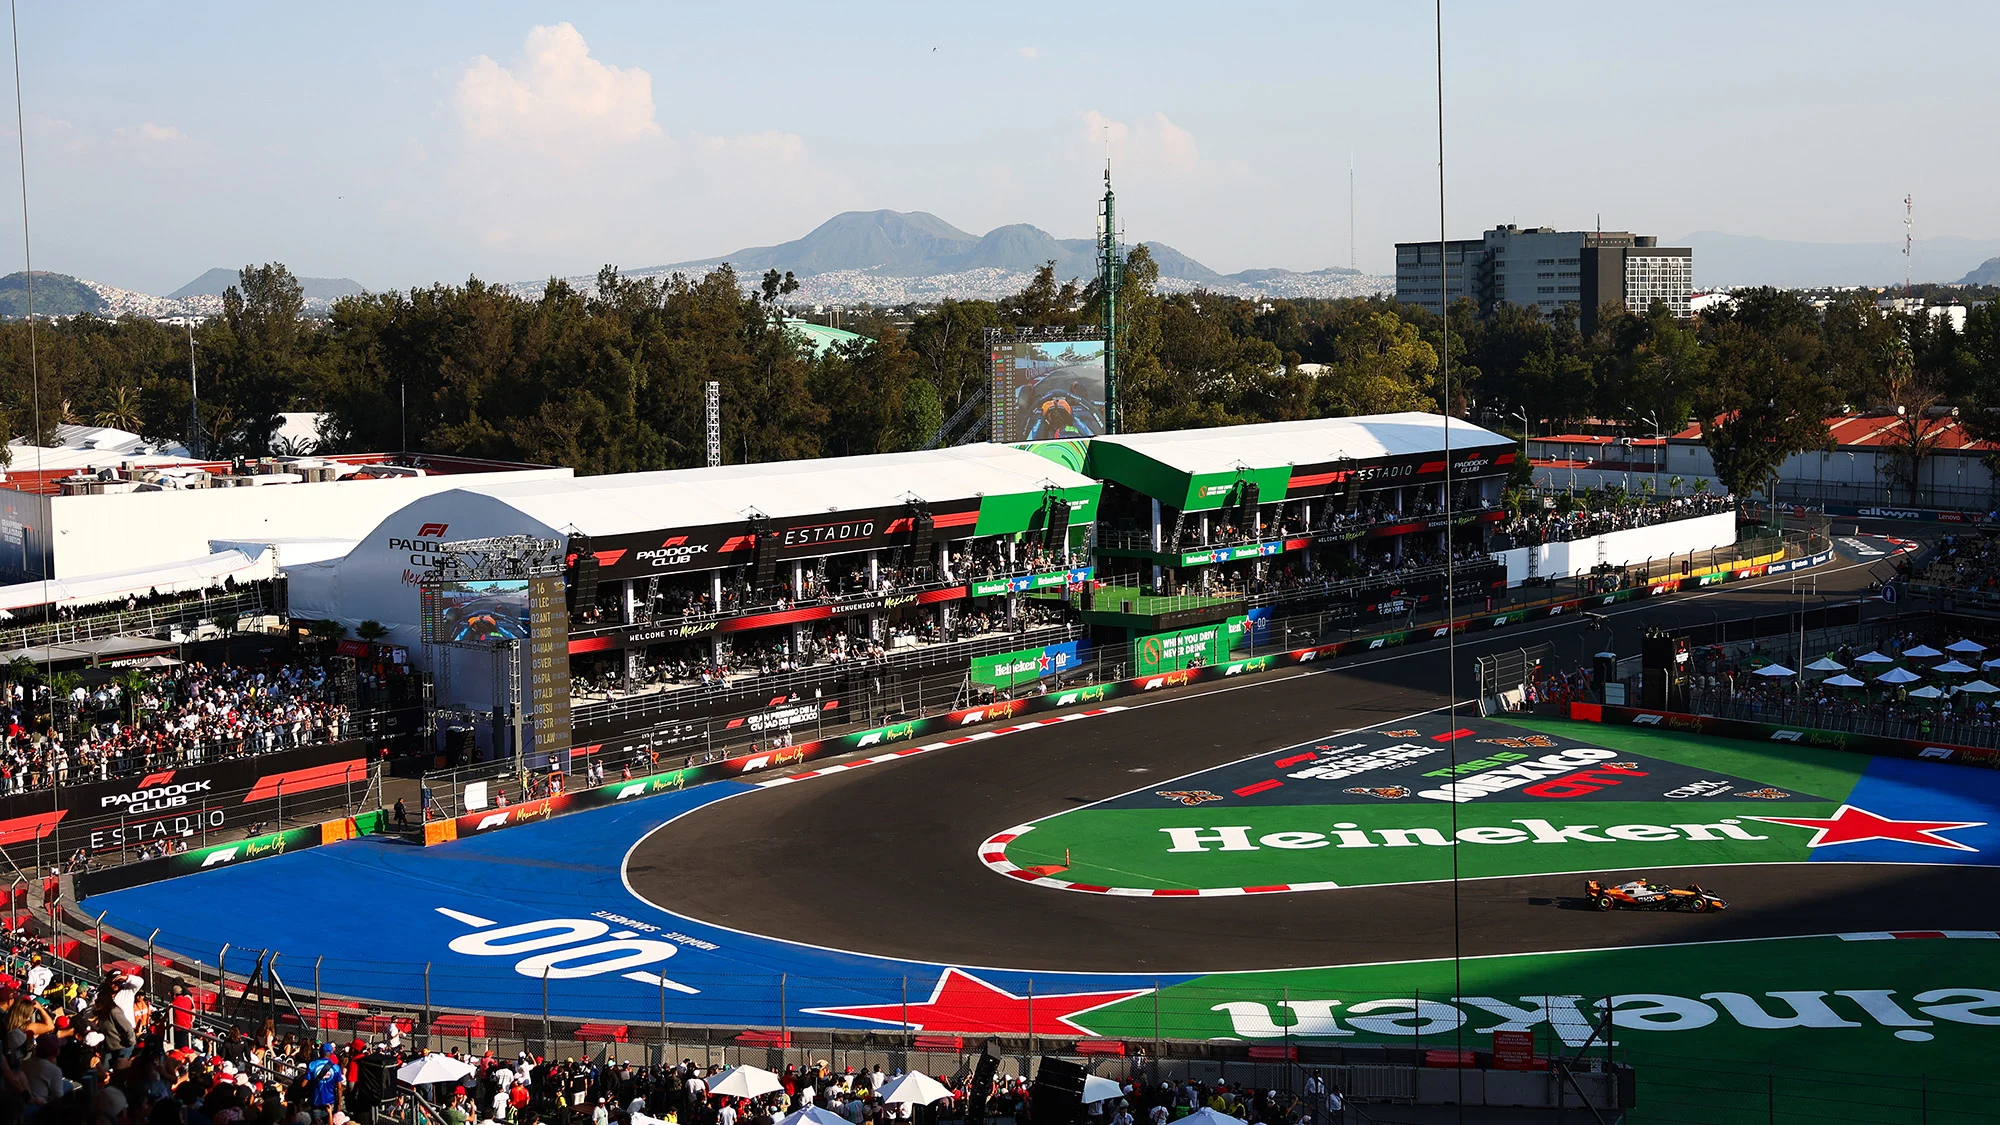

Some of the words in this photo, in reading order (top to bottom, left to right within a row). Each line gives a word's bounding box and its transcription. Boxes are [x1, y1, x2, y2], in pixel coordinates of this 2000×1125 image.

[1454, 459, 1489, 469] PADDOCK
[1460, 466, 1480, 474] CLUB
[1357, 465, 1413, 481] ESTADIO
[1858, 508, 1919, 518] allwyn
[1938, 513, 1961, 521] Lenovo
[1428, 519, 1453, 528] BIENVENIO
[784, 522, 874, 545] ESTADIO
[636, 544, 709, 560] PADDOCK
[652, 555, 691, 567] CLUB
[536, 583, 545, 595] 16
[530, 599, 538, 608] 01
[538, 597, 550, 608] LEC
[831, 602, 876, 614] BIENVENIDO
[884, 594, 919, 610] Mexico
[531, 613, 540, 624] 02
[540, 611, 551, 623] ANT
[531, 629, 540, 639] 03
[540, 627, 552, 638] NOR
[629, 630, 666, 642] WELCOME
[669, 628, 679, 637] TO
[679, 621, 719, 638] Mexico
[532, 644, 541, 655] 04
[540, 642, 553, 654] HAM
[1163, 637, 1183, 649] WHEN
[1185, 634, 1198, 644] YOU
[1164, 647, 1185, 658] NEVER
[1186, 642, 1206, 654] DRINK
[532, 659, 541, 669] 05
[541, 657, 552, 669] VER
[995, 657, 1037, 677] Heineken
[533, 674, 541, 684] 06
[541, 673, 551, 684] PIA
[533, 689, 542, 699] 07
[542, 687, 553, 699] ALB
[1082, 691, 1095, 701] Mexico
[534, 704, 543, 714] 08
[542, 703, 553, 714] TSU
[770, 708, 799, 720] PREMIO
[988, 708, 1003, 719] Mexico
[534, 719, 543, 730] 09
[543, 717, 554, 729] STR
[1669, 716, 1689, 727] Mexico
[1690, 716, 1704, 729] City
[535, 734, 543, 744] 10
[543, 732, 556, 744] LAW
[1810, 733, 1831, 745] Mexico
[1831, 734, 1846, 750] City
[774, 751, 794, 764] Mexico
[794, 745, 804, 763] City
[1287, 755, 1377, 780] MEXICO
[1369, 743, 1423, 757] CITY
[1961, 750, 1984, 763] Mexico
[1984, 750, 2000, 768] City
[1316, 758, 1396, 780] GRAND
[1385, 746, 1445, 762] PRIX
[1421, 757, 1494, 777] THIS
[1488, 752, 1529, 767] IS
[653, 778, 672, 792] Mexico
[673, 770, 685, 790] City
[1417, 748, 1618, 803] MEXICO
[1522, 763, 1650, 798] CITY
[101, 779, 212, 807] PADDOCK
[1663, 780, 1726, 798] CDMX
[129, 795, 187, 814] CLUB
[517, 807, 539, 822] Mexico
[539, 800, 553, 819] City
[91, 810, 224, 848] ESTADIO
[1159, 819, 1768, 853] Heineken
[246, 843, 271, 857] Mexico
[271, 833, 286, 855] City
